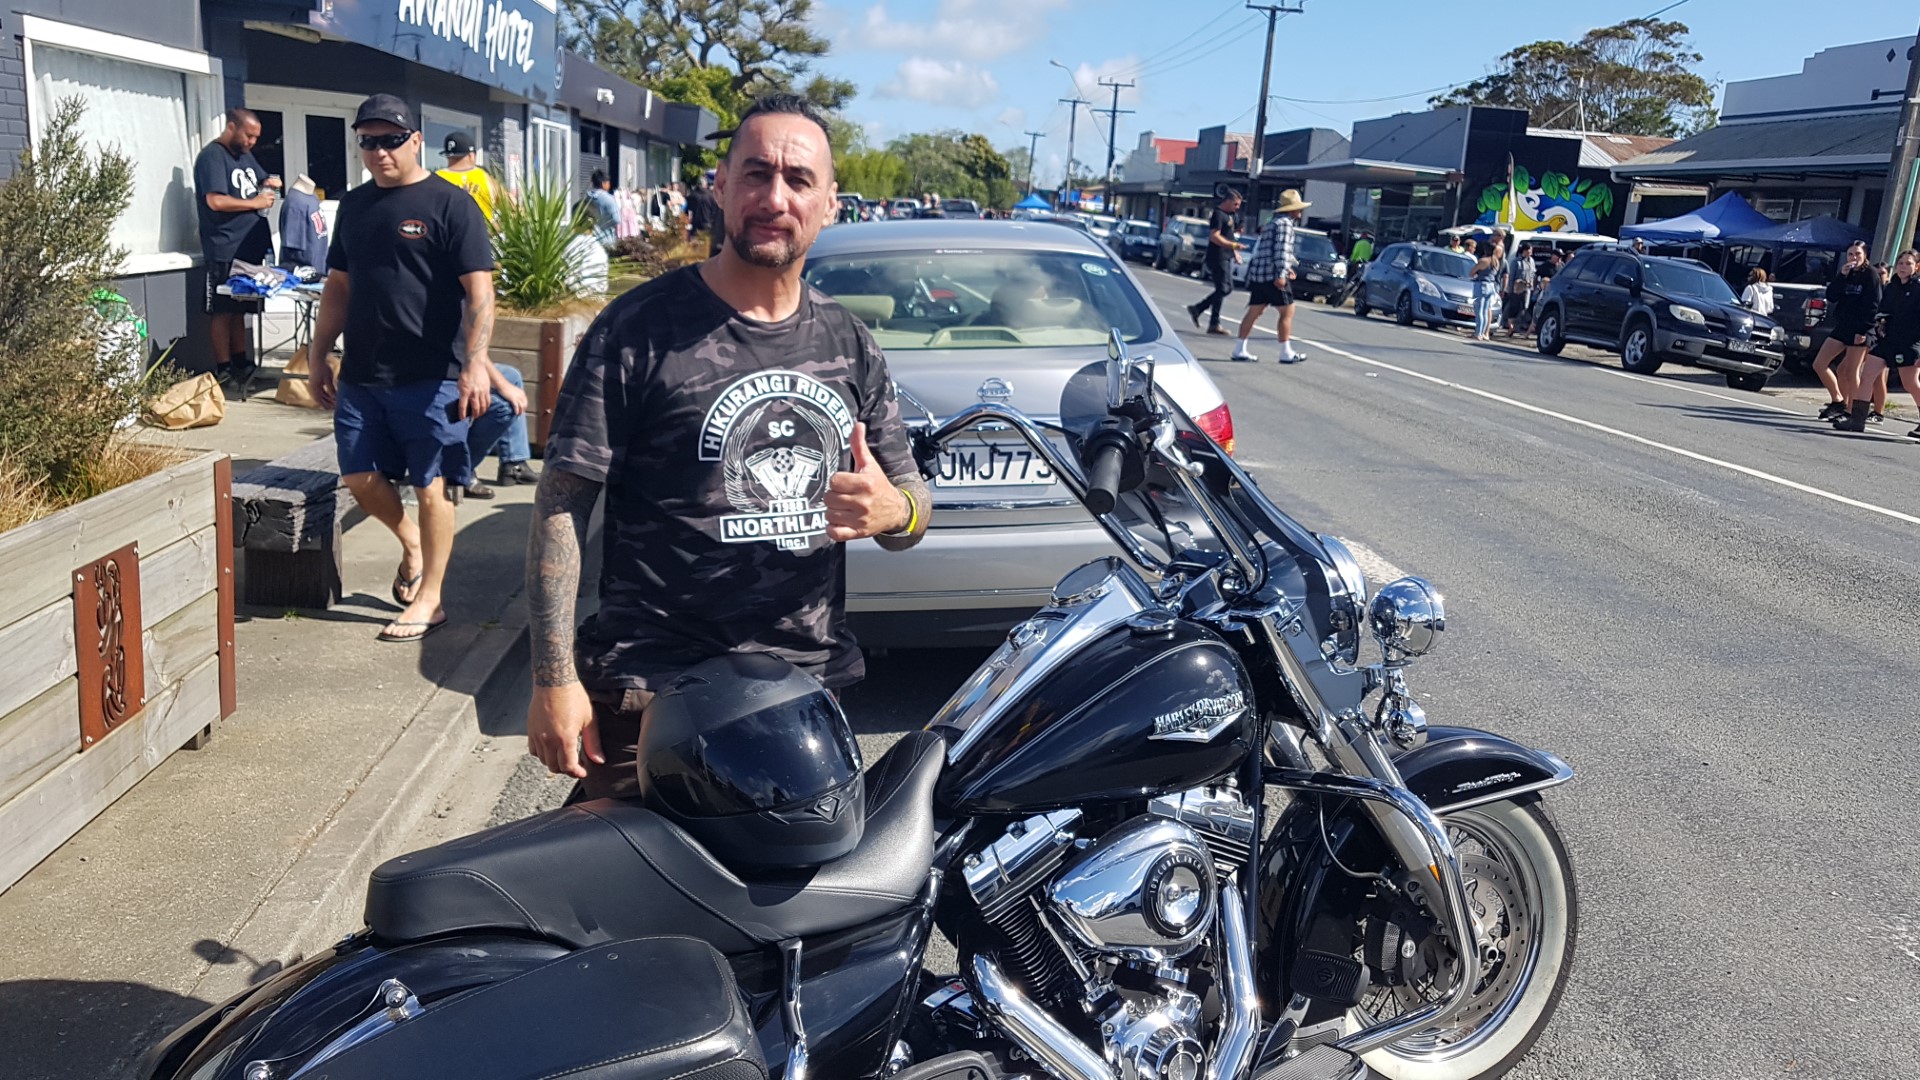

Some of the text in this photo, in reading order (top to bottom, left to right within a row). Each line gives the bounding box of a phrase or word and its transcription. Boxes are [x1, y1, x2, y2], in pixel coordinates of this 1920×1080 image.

[485, 1, 534, 73] HOTEL
[704, 375, 852, 451] HIKURANGI RIDERS
[767, 419, 795, 438] SC
[727, 513, 829, 537] NORTHLA
[781, 537, 804, 548] Inc.
[1157, 855, 1182, 876] CUBIC
